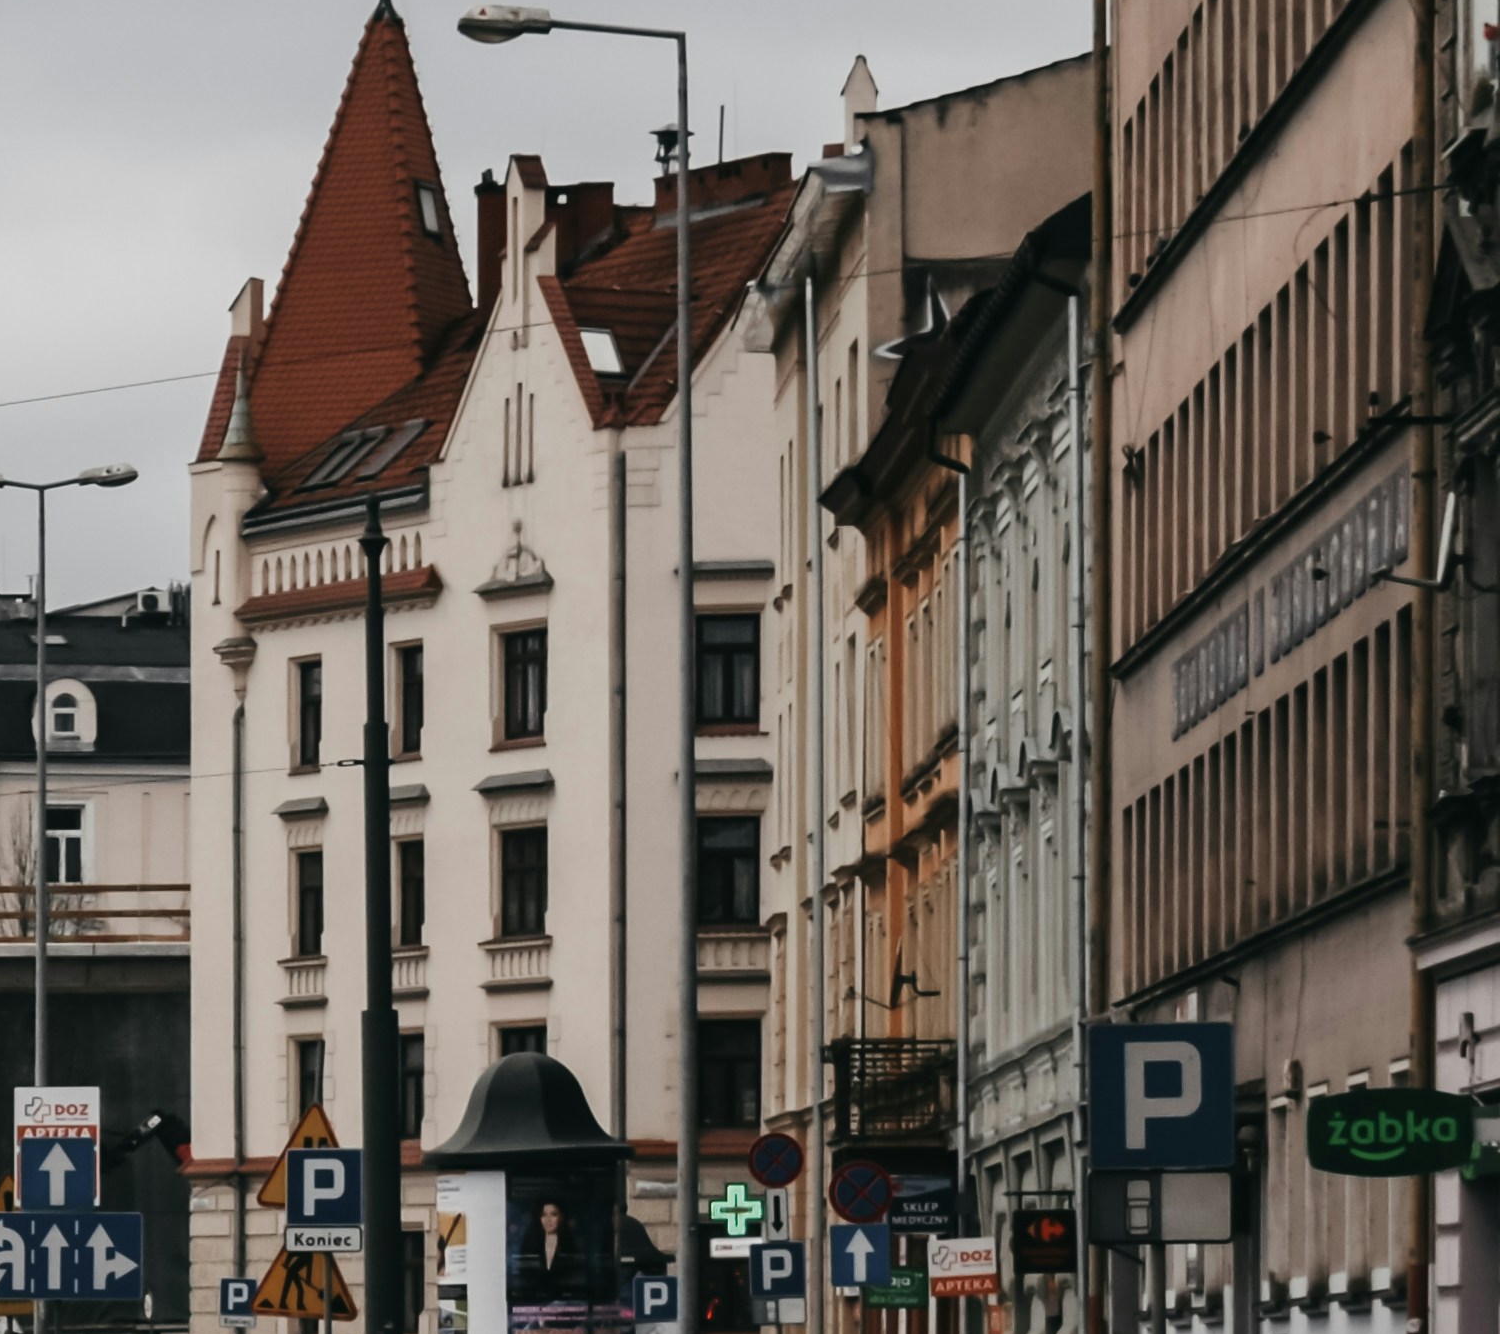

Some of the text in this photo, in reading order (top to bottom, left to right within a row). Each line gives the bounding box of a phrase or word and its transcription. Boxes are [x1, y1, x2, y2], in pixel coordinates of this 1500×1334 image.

[1123, 1040, 1203, 1151] P
[54, 1104, 89, 1116] DOZ
[1326, 1109, 1459, 1146] żabka
[303, 1158, 346, 1217] P
[902, 1202, 940, 1212] SKLEP
[892, 1215, 949, 1225] MEDYCZNY
[294, 1232, 352, 1247] Koniec
[960, 1249, 993, 1262] DOZ
[761, 1248, 794, 1291] P
[228, 1282, 249, 1311] P
[934, 1278, 995, 1294] APTEKA
[643, 1281, 669, 1316] P
